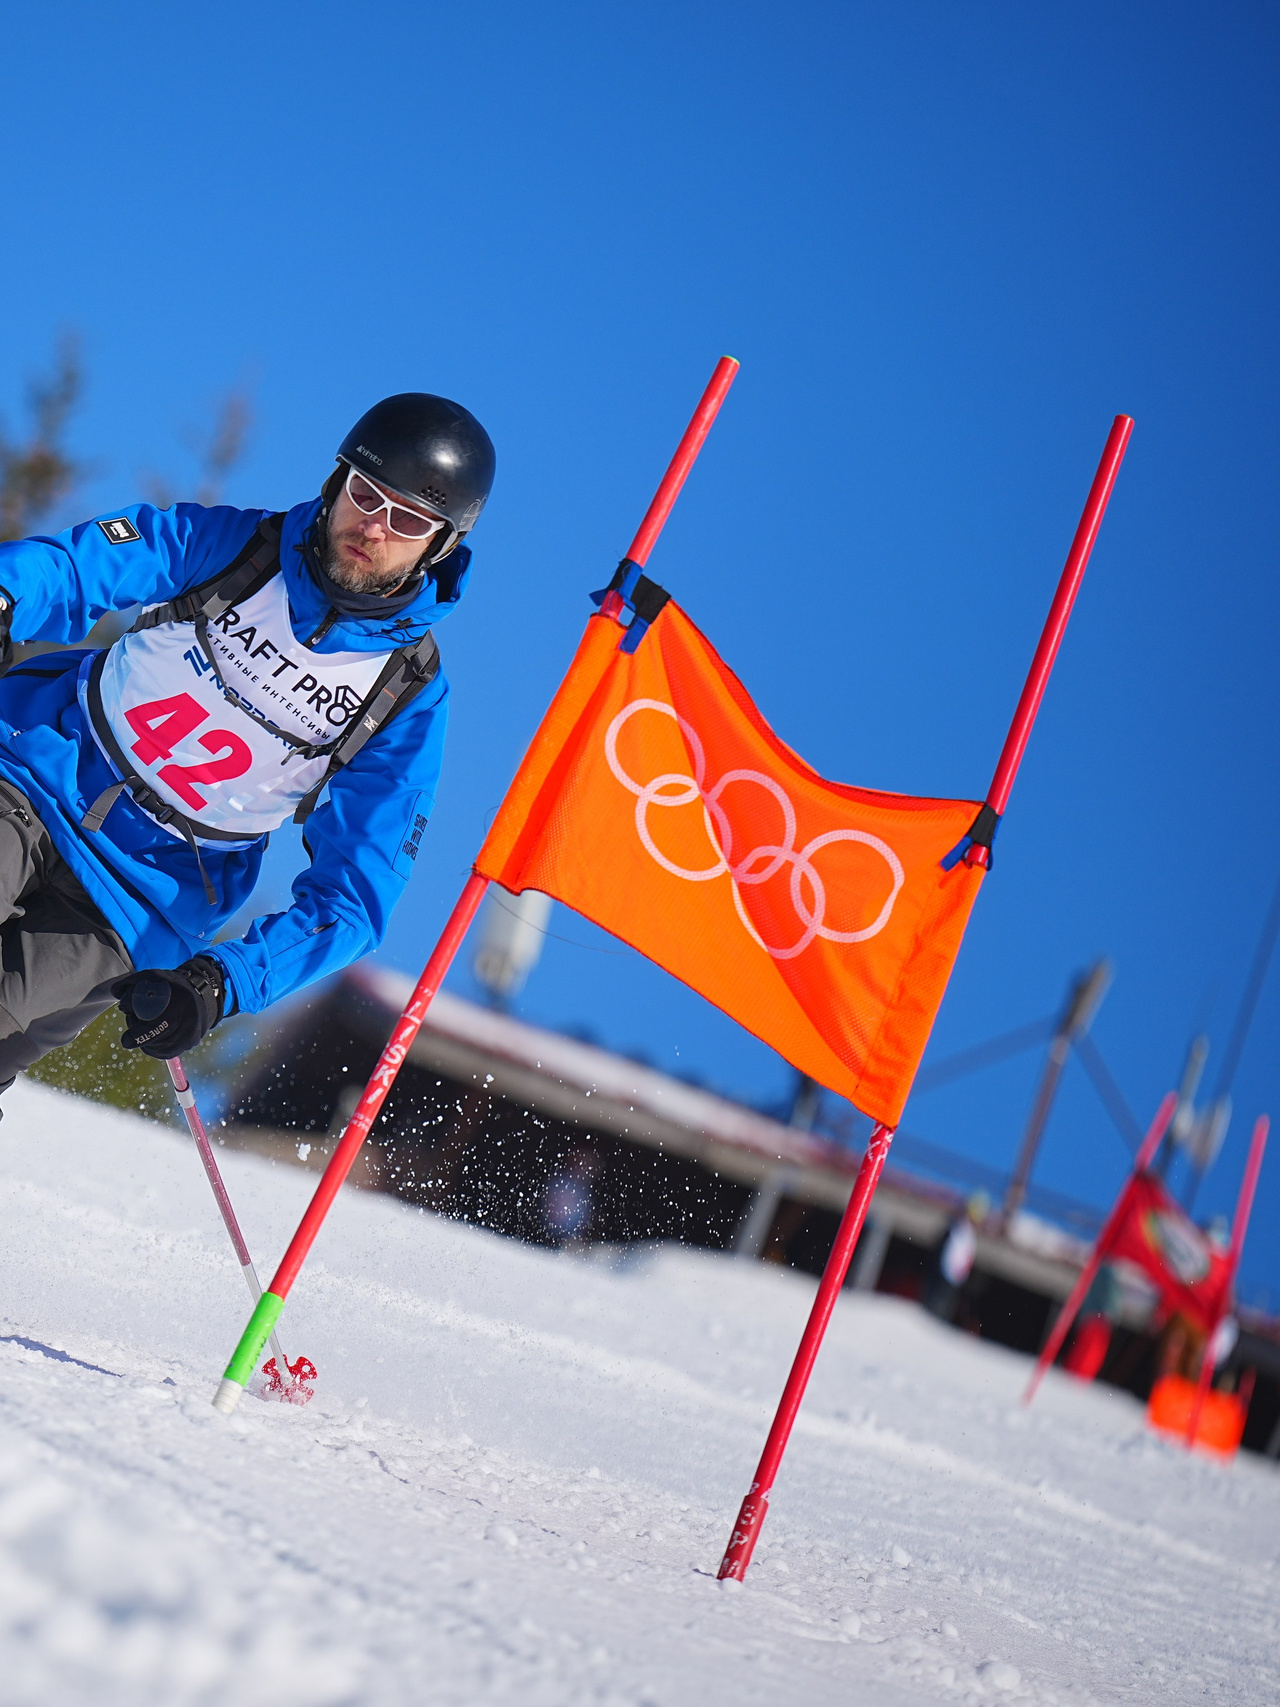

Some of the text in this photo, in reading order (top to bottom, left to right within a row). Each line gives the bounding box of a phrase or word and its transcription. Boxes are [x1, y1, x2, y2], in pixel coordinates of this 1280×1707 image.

[207, 633, 331, 741] РТИВНЫЕ ИНТЕНСИВЫ
[213, 608, 352, 727] RAFT PRO
[124, 691, 253, 812] 42
[134, 1020, 170, 1045] GORE-TEX
[365, 1001, 422, 1105] LISKI
